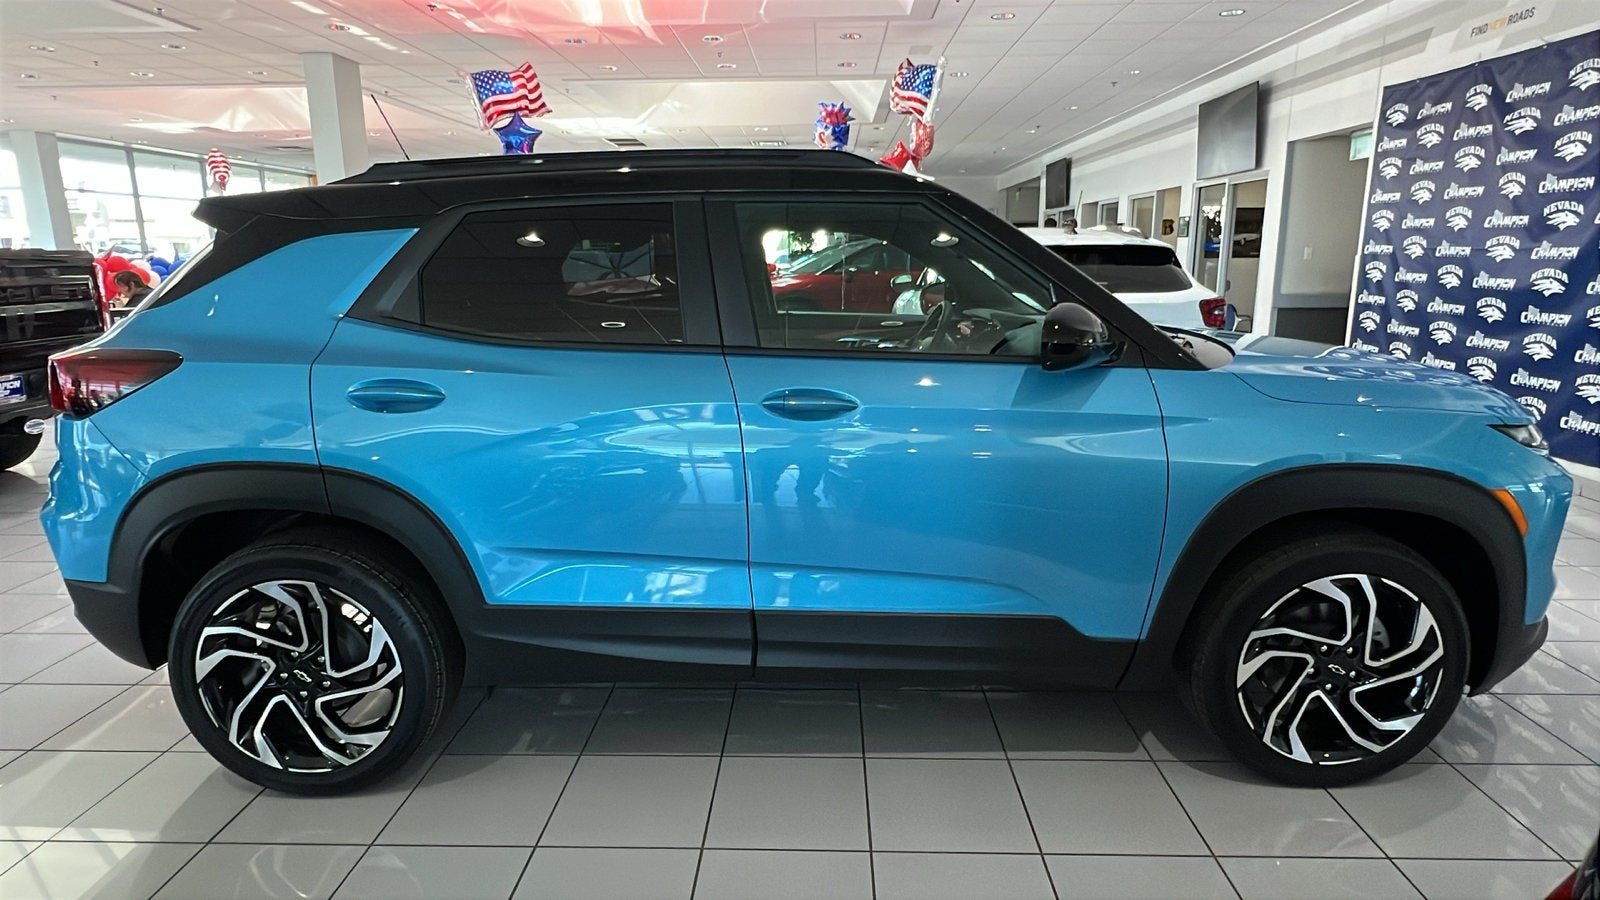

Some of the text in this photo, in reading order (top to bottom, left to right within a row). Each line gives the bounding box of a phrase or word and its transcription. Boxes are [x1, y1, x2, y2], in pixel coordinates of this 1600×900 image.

[1471, 23, 1489, 38] FIND
[1507, 6, 1536, 26] ROADS
[1505, 81, 1551, 103] CHAMPION
[1503, 107, 1541, 124] NEVADA
[1416, 123, 1444, 138] NEVADA
[1554, 131, 1593, 149] NEVADA
[1454, 146, 1485, 160] NEVADA
[1496, 149, 1538, 166] CHAMPION
[1443, 186, 1485, 199] CHAMPION
[1538, 176, 1595, 194] CHAMPION
[1543, 201, 1584, 217] NEVADA
[1484, 215, 1529, 228] CHAMPION
[1485, 235, 1520, 250] NEVADA
[1531, 246, 1580, 260] CHAMPION
[1472, 277, 1517, 290] CHAMPION
[1529, 268, 1569, 284] NEVADA
[1427, 302, 1465, 315] CHAMPION
[1476, 297, 1507, 312] NEVADA
[1520, 311, 1572, 326] CHAMPION
[1428, 321, 1457, 336] NEVADA
[1465, 336, 1510, 351] CHAMPION
[1522, 333, 1557, 350] NEVADA
[1467, 356, 1497, 373] NEVADA
[1510, 373, 1561, 392] CHAMPION
